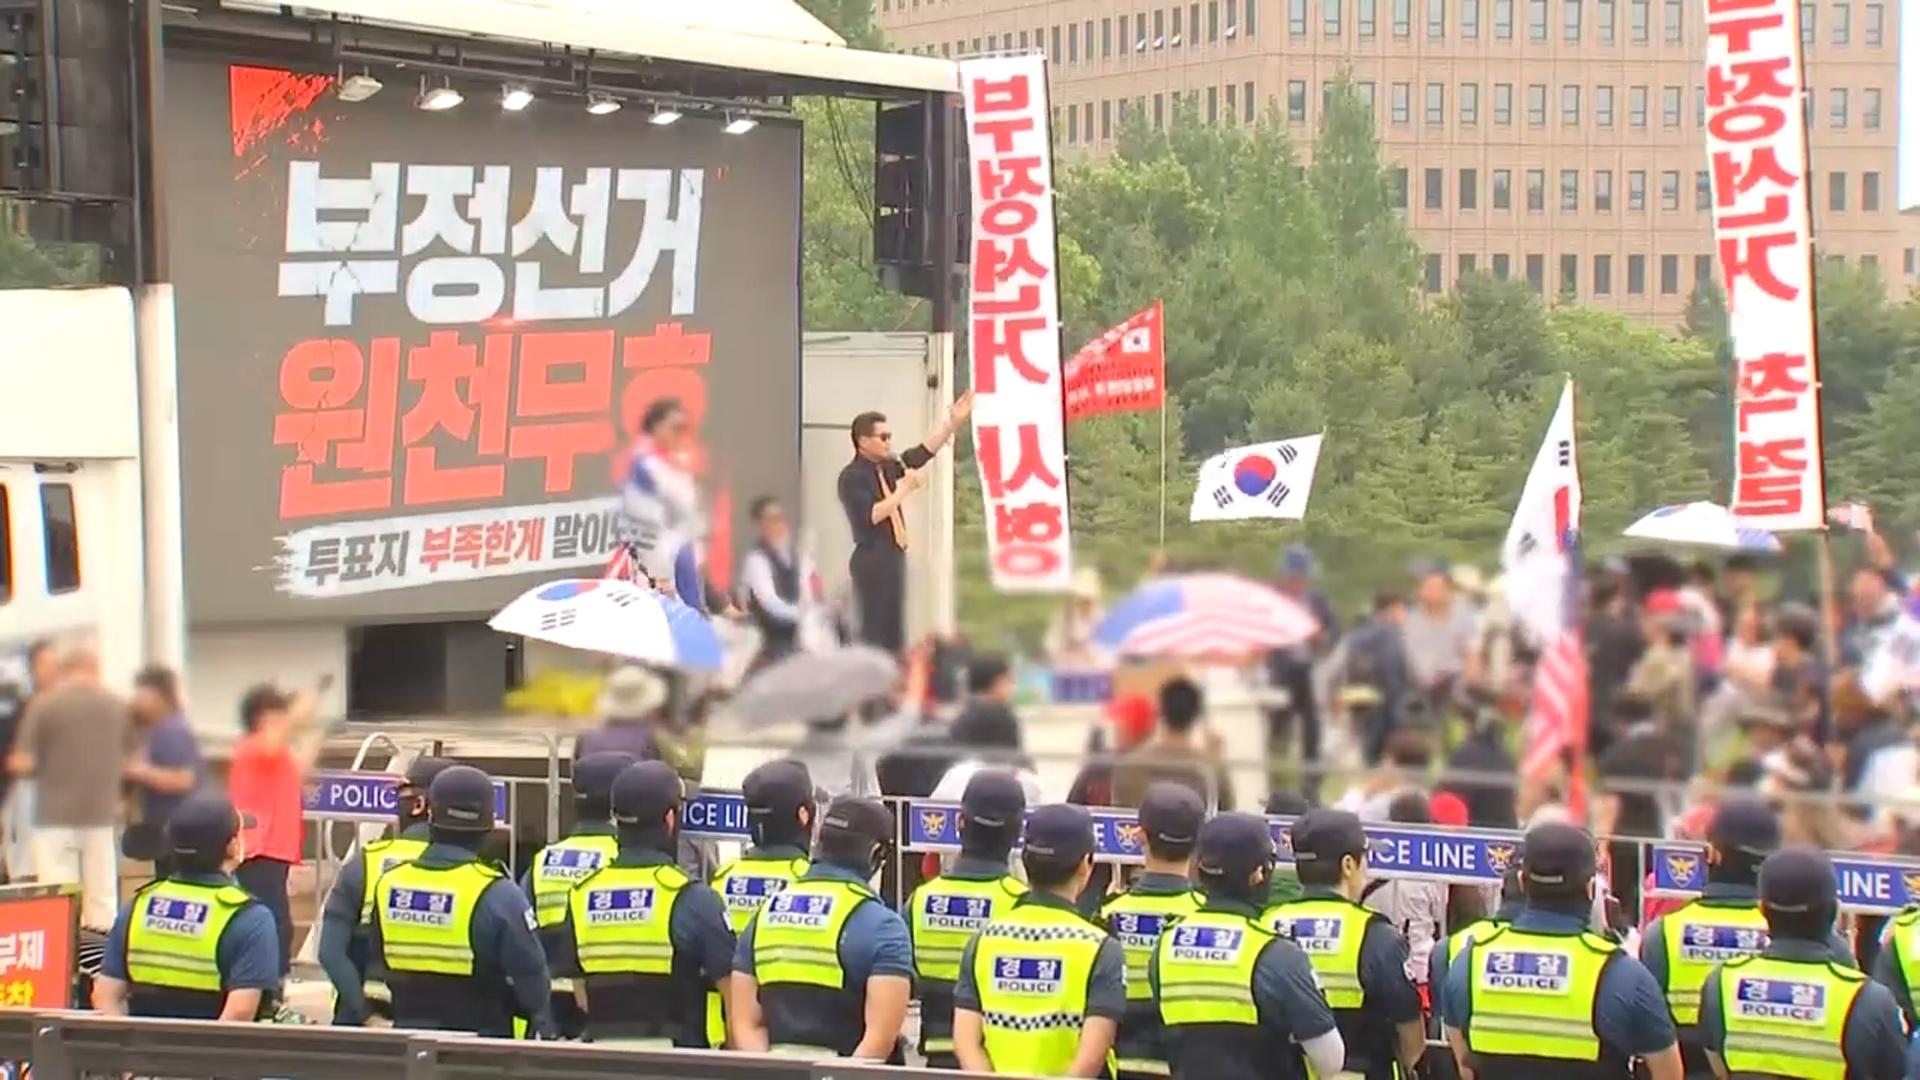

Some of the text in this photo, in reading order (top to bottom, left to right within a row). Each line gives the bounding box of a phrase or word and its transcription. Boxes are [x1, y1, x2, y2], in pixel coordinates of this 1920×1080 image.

[277, 161, 704, 326] 부정선거
[304, 529, 410, 586] 투표지
[420, 516, 546, 573] 부족한게
[330, 784, 397, 808] POLIC
[683, 803, 748, 828] ICE LI
[1421, 841, 1475, 870] LINE
[1836, 870, 1891, 899] INE
[727, 897, 764, 908] POLI
[392, 912, 445, 924] POLICE
[591, 910, 646, 923] POLICE
[769, 914, 821, 926] POLICE
[147, 918, 197, 934] POLICE
[1174, 948, 1230, 961] POLICE
[1688, 948, 1747, 960] POLIC
[998, 980, 1056, 993] POLICE
[1489, 975, 1560, 989] POLICE
[1741, 1004, 1815, 1020] POLICE
